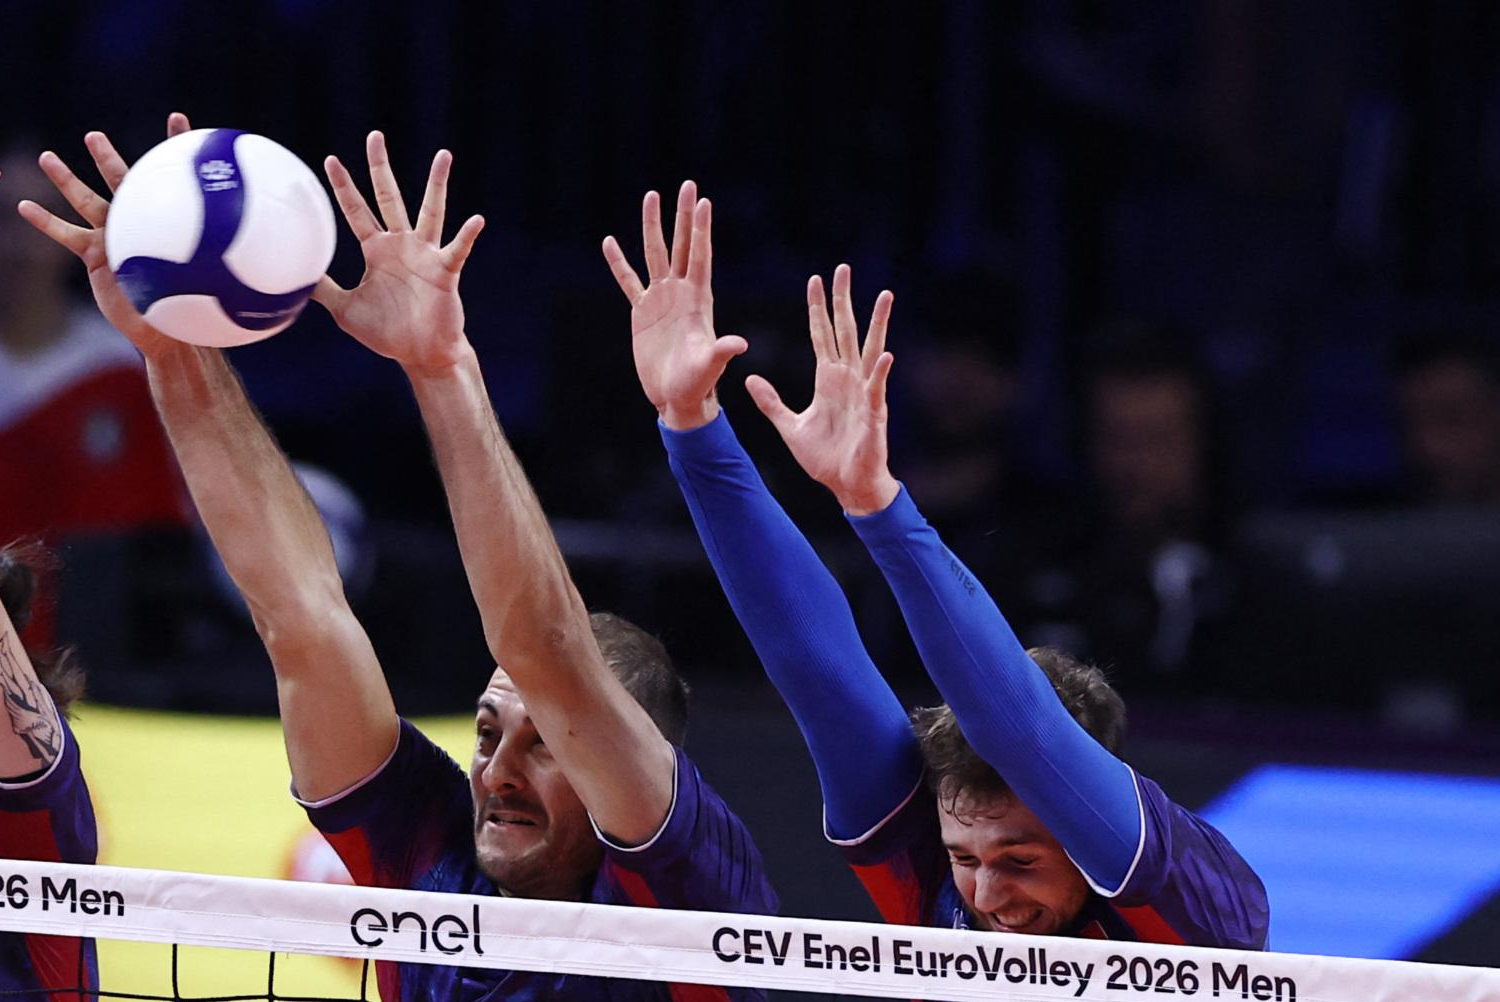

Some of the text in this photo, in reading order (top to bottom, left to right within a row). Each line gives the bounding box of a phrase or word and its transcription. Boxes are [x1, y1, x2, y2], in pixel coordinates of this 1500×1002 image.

[42, 876, 125, 917] Men
[350, 903, 485, 957] enel
[711, 926, 792, 966] CEV
[803, 933, 881, 973] Enel
[892, 939, 1095, 997] EuroVolley
[1106, 954, 1200, 995] 2026
